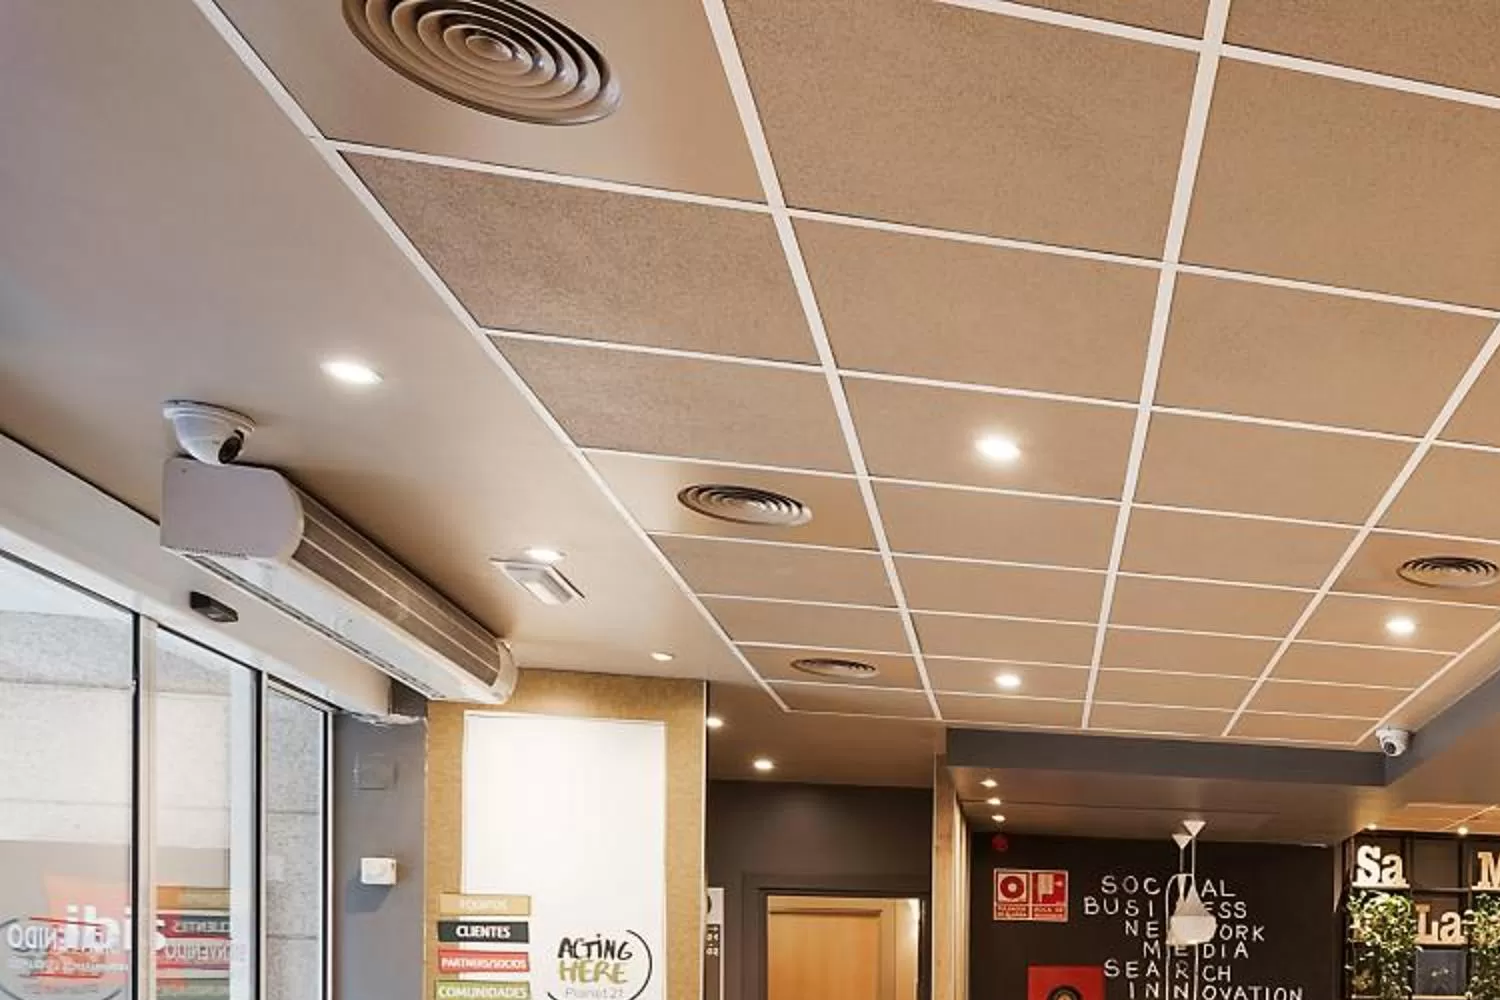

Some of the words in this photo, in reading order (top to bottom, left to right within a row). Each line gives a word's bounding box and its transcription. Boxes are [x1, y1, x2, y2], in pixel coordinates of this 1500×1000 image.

[1356, 845, 1408, 885] Sa
[1101, 875, 1236, 898] SOCAL
[1084, 896, 1247, 919] BUSISS
[456, 925, 511, 939] CLIENTES
[1125, 920, 1265, 942] NEORK
[1415, 905, 1464, 942] La
[1143, 940, 1249, 959] MEDIA
[559, 960, 628, 984] HERE
[1103, 959, 1231, 982] SEARCH
[438, 986, 527, 999] COMUNIDADES
